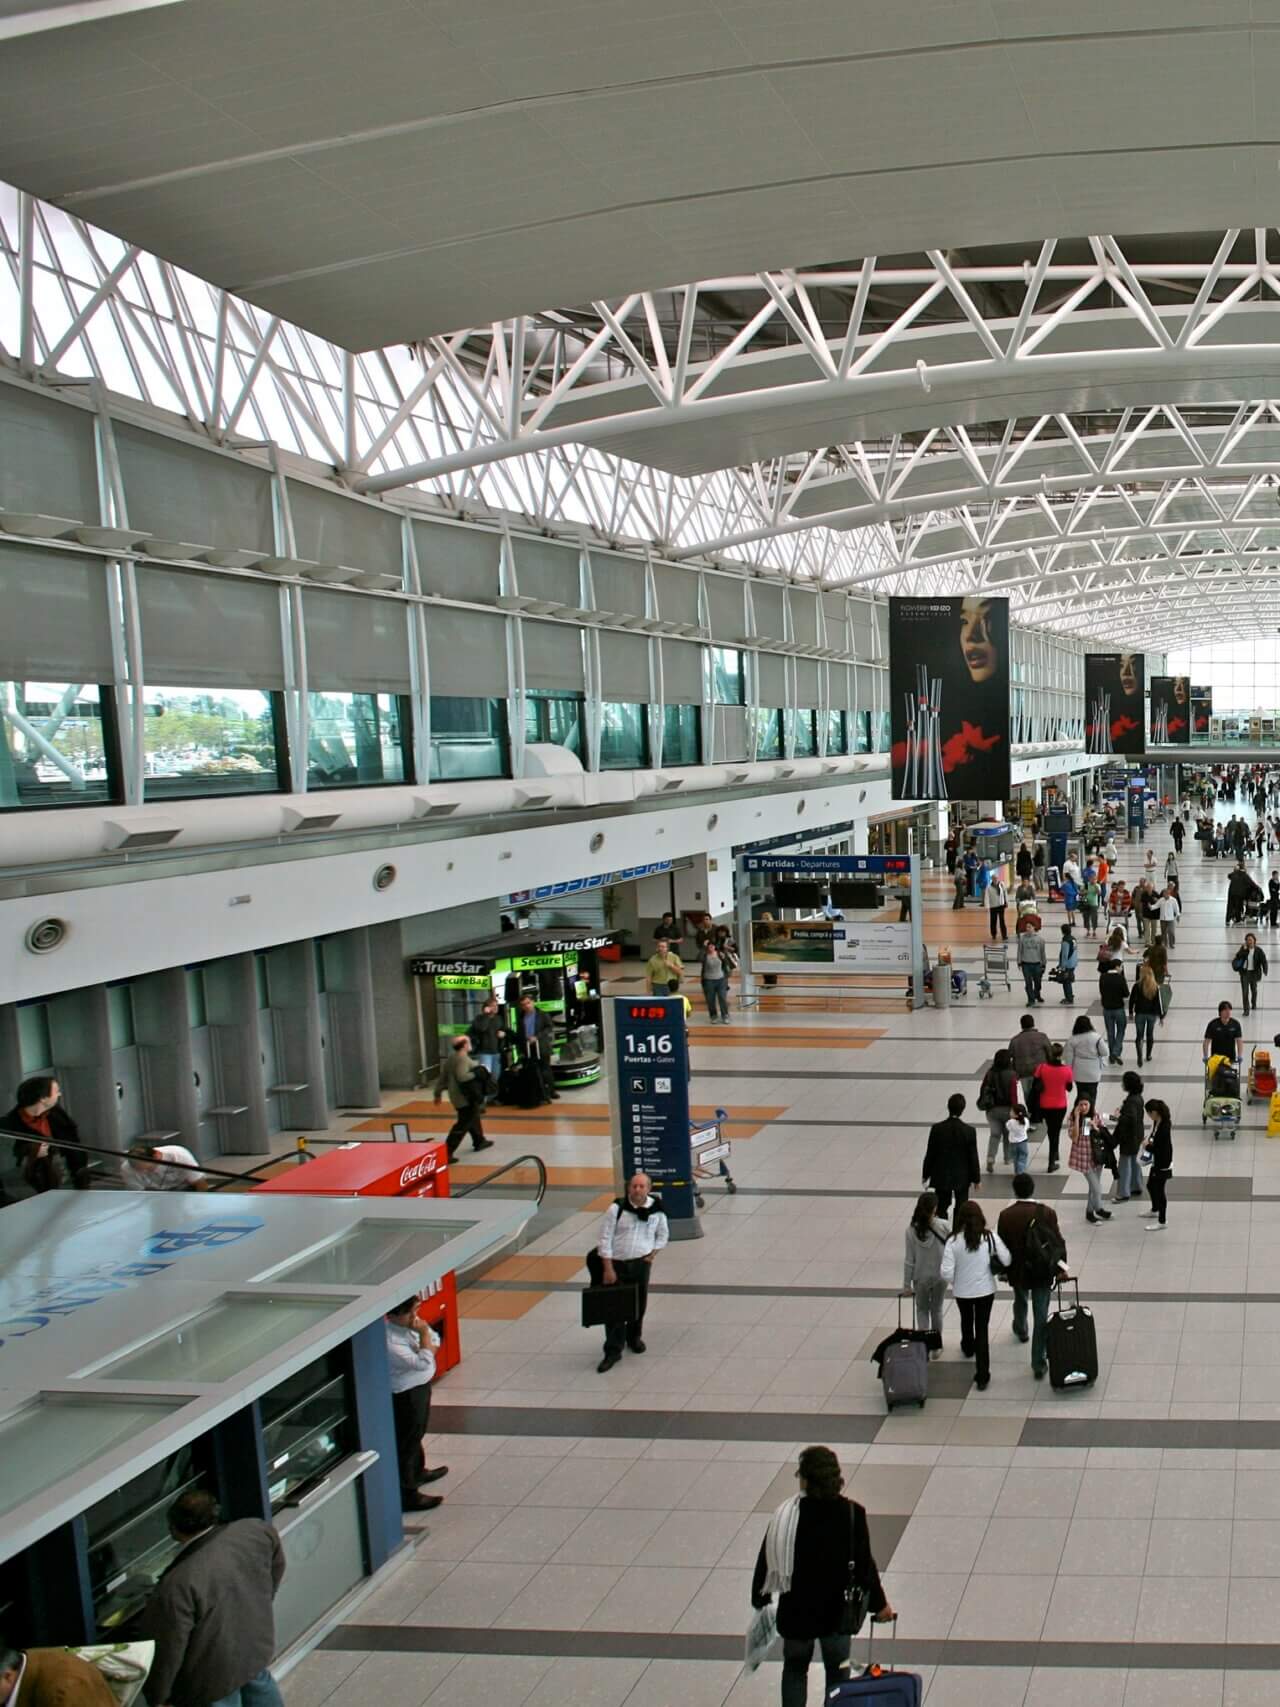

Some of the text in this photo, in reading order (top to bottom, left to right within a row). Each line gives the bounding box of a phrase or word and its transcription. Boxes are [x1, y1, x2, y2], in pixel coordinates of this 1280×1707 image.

[761, 859, 841, 869] Partidas Departures
[549, 937, 609, 951] TrueStar
[423, 960, 485, 973] TrueStar
[521, 956, 560, 967] Secure
[436, 976, 489, 988] SecureBag
[624, 1055, 652, 1063] Puertas
